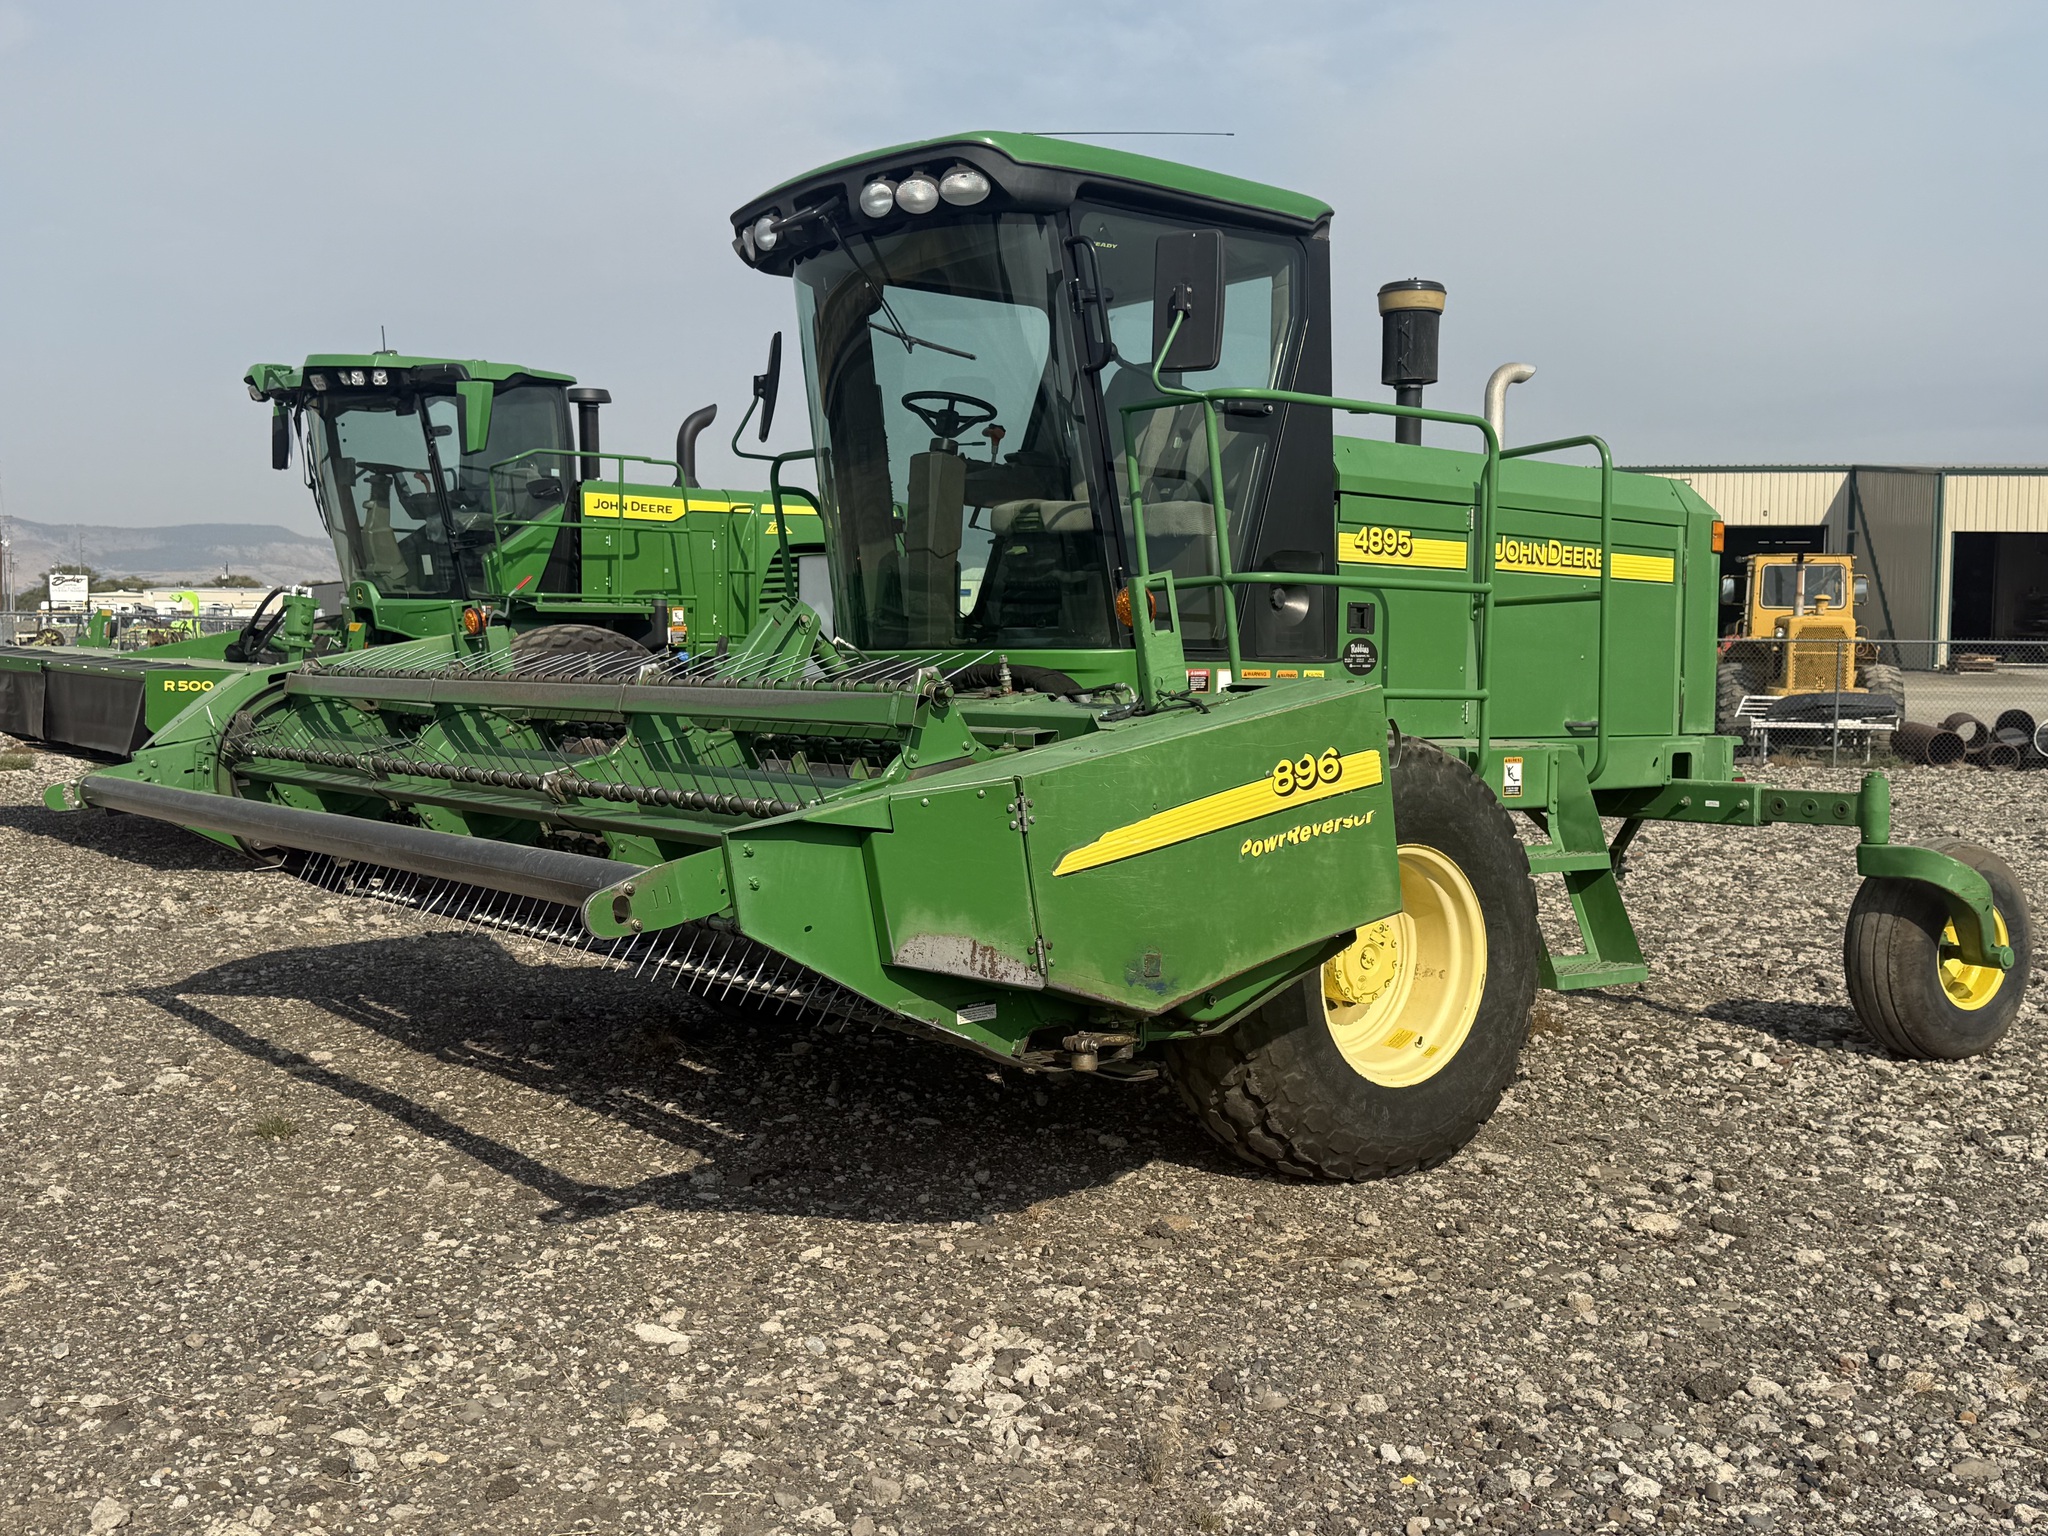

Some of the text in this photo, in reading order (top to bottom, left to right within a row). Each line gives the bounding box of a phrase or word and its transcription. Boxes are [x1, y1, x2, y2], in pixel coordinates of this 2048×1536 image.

[1093, 240, 1118, 249] EADY
[631, 501, 673, 514] DEERE
[1354, 525, 1413, 557] 4895
[1495, 535, 1547, 565] JOHN
[164, 680, 215, 692] R 500
[1272, 747, 1342, 796] 896
